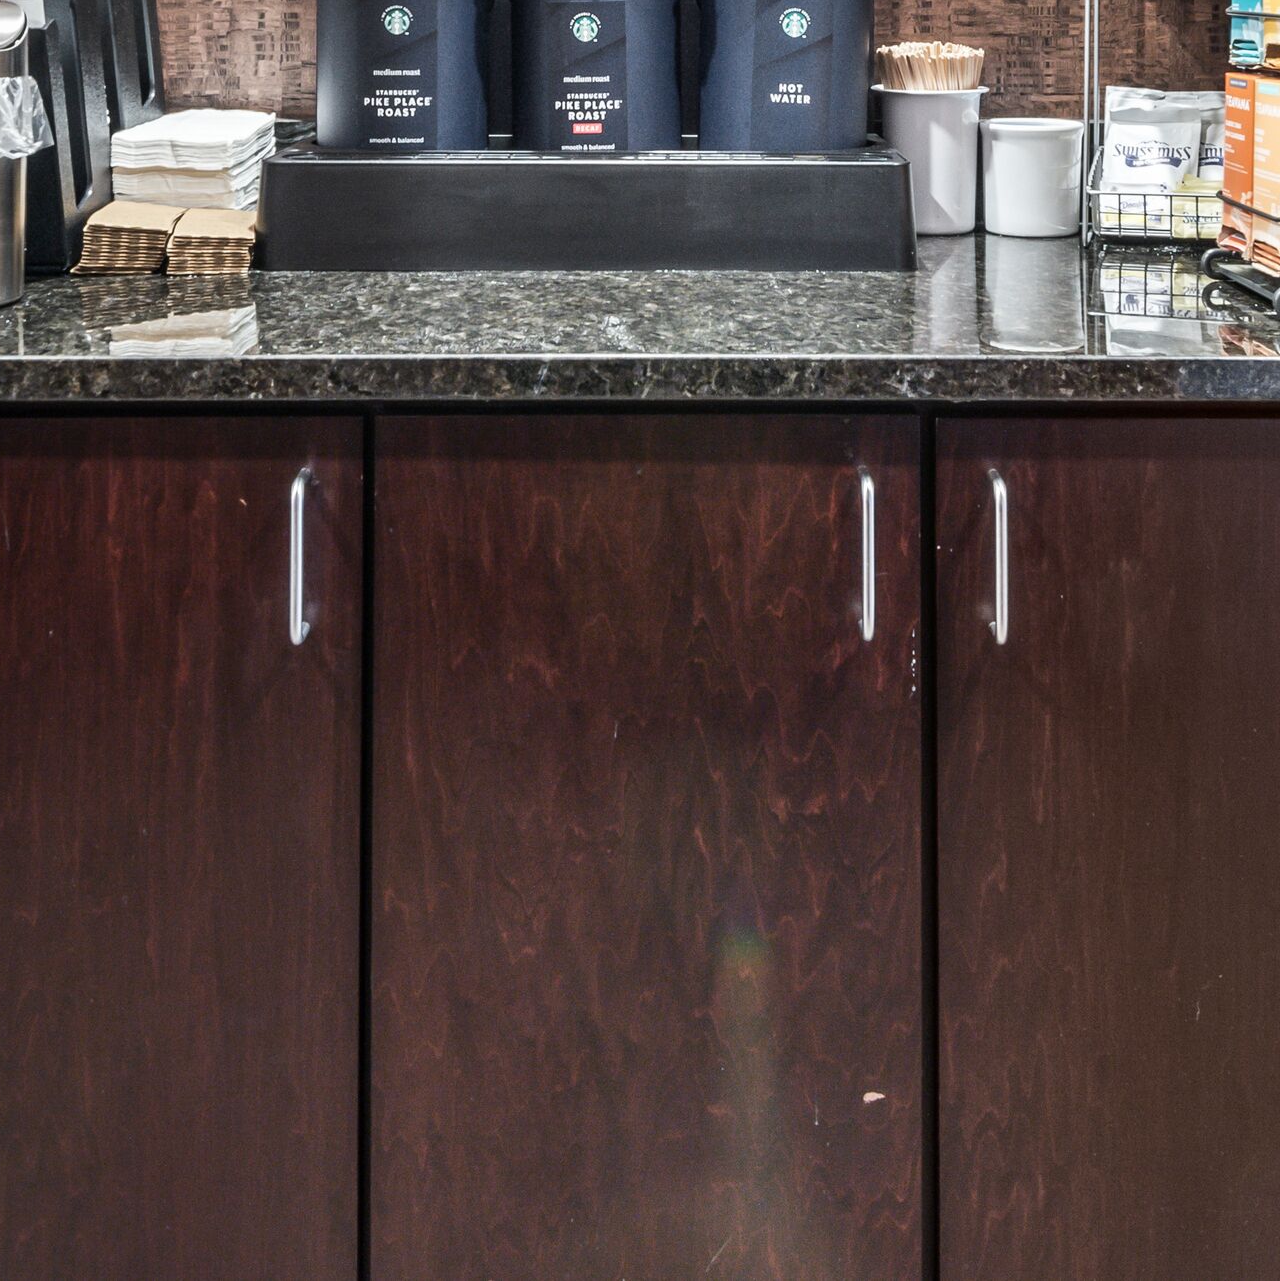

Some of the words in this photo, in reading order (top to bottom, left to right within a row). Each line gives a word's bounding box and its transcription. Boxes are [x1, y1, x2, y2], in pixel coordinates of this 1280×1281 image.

[373, 68, 402, 76] medium
[402, 68, 421, 76] roast
[563, 75, 592, 83] medium
[779, 83, 804, 93] HOT
[363, 97, 390, 106] PIKE
[770, 93, 811, 104] WATER
[555, 101, 580, 110] PIKE
[377, 108, 417, 117] ROAST
[568, 111, 607, 121] ROAST
